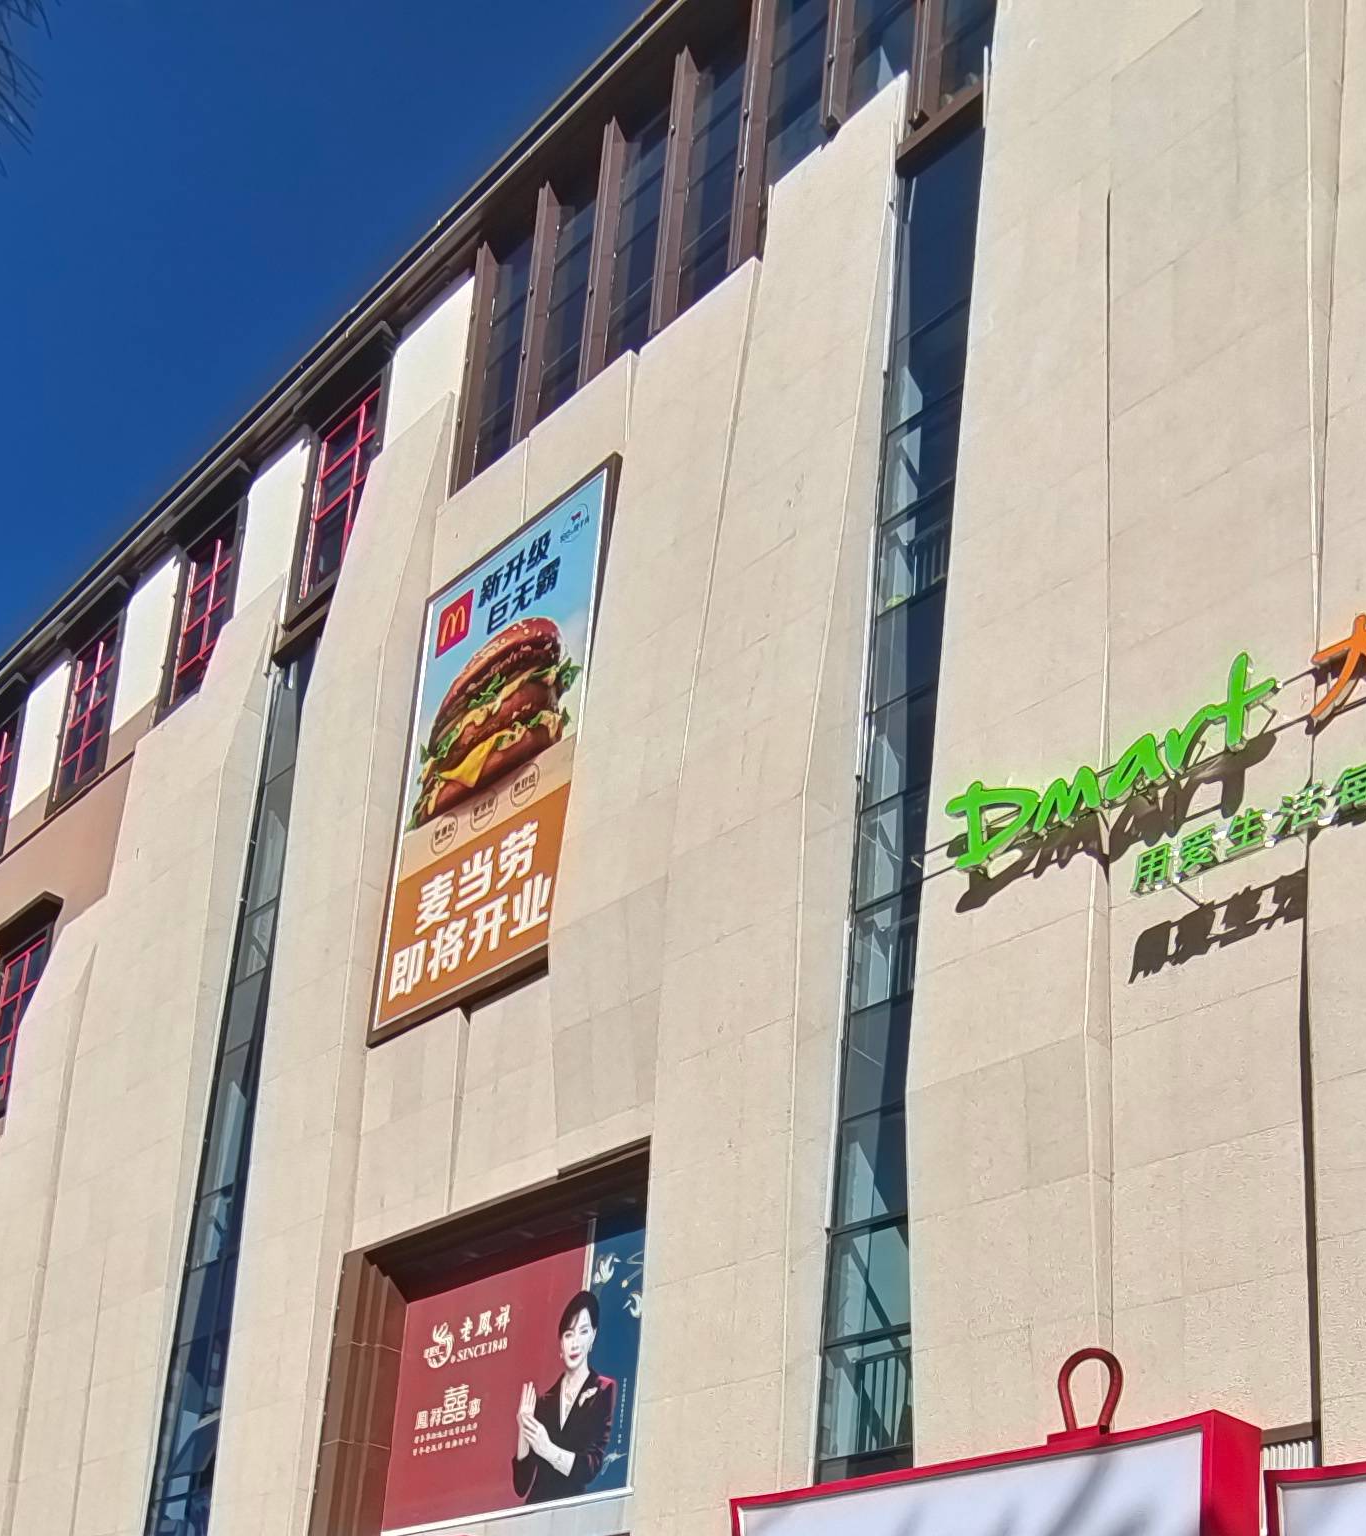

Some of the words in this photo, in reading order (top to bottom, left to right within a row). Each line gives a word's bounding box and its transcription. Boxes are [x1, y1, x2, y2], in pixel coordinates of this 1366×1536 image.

[477, 529, 552, 608] 新升级
[486, 556, 562, 636] 巨无霸
[943, 651, 1282, 870] Dmart
[414, 820, 540, 935] 麦当劳
[387, 873, 552, 1003] 即将开业
